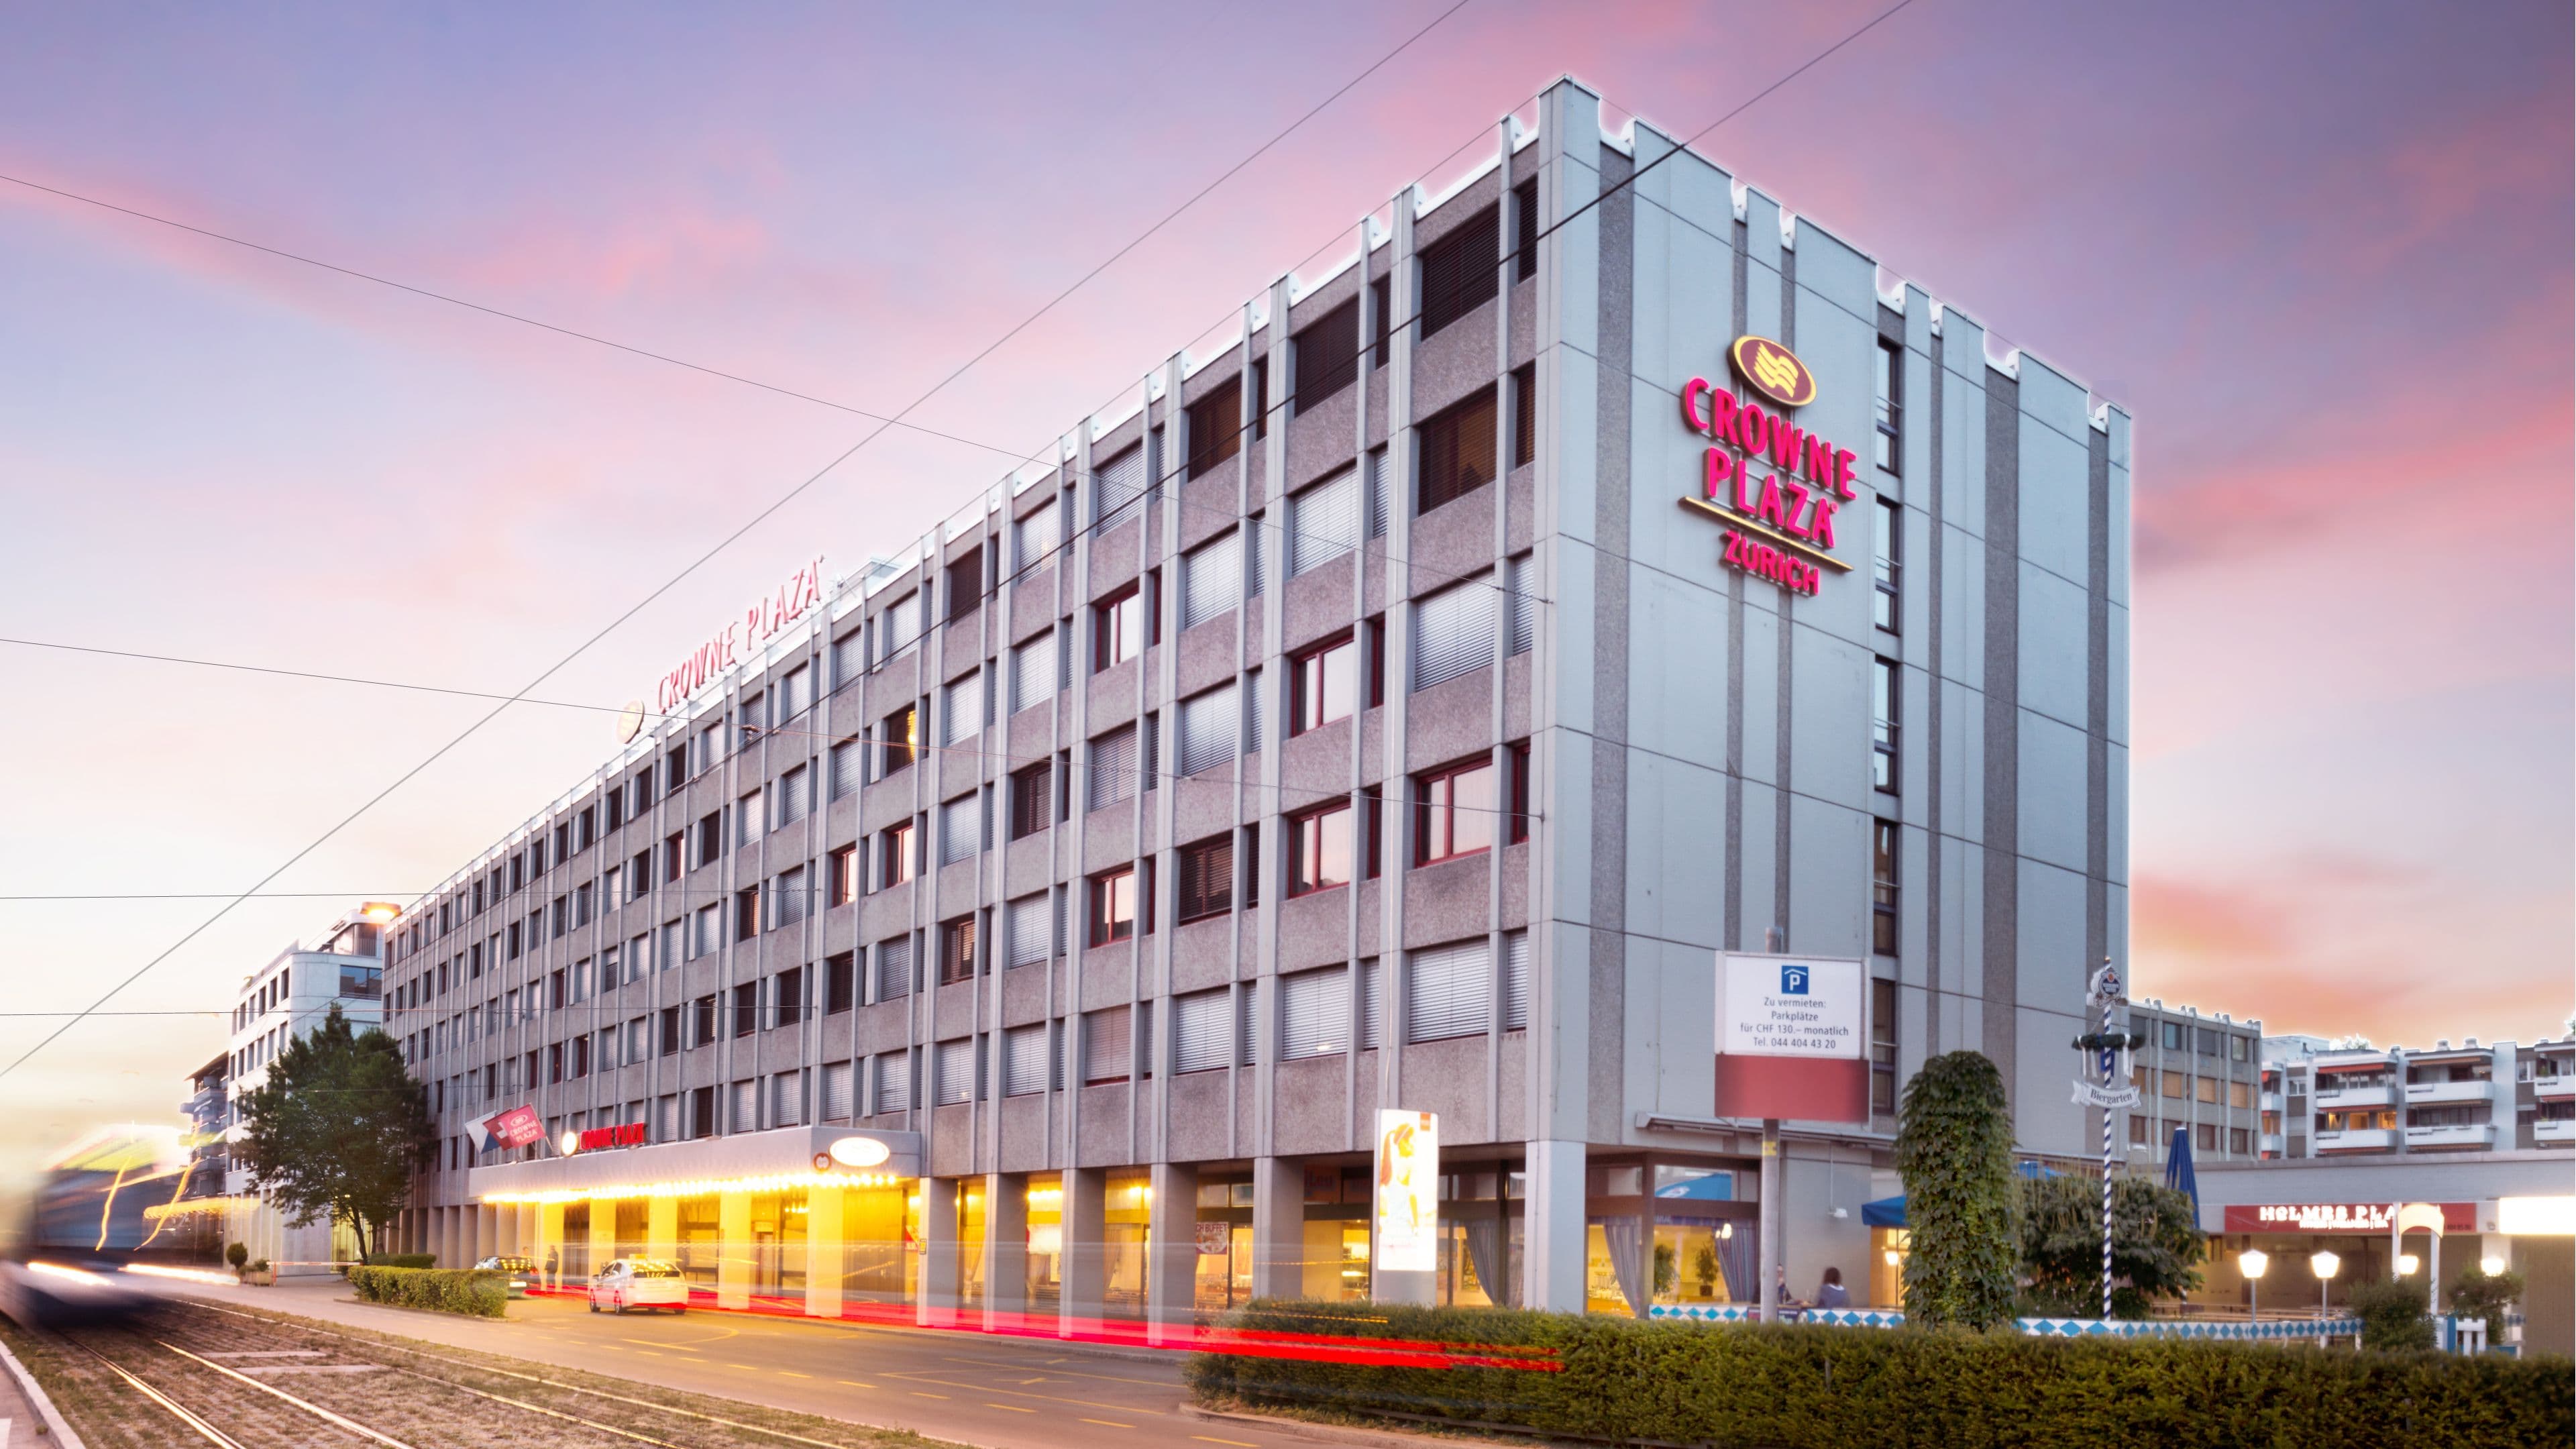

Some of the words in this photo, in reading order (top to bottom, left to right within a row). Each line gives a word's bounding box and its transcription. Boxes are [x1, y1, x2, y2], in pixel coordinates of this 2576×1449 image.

[1682, 376, 1857, 500] CROWNE
[1723, 530, 1819, 596] ZURICH
[658, 621, 738, 714] CROWNE
[1789, 974, 1801, 991] P
[1764, 997, 1775, 1006] Zu
[1778, 998, 1826, 1009] vermieten:
[1771, 1011, 1819, 1022] Parkplätze
[1740, 1022, 1753, 1032] für
[1756, 1024, 1774, 1034] CHF
[1804, 1026, 1849, 1036] monatlich
[1753, 1036, 1768, 1046] Tel.
[1771, 1038, 1788, 1047] 044
[1791, 1038, 1807, 1048] 404
[1811, 1039, 1822, 1049] 43
[1825, 1039, 1836, 1049] 20
[2090, 1088, 2132, 1106] Biergarten
[1205, 1223, 1228, 1232] BUFFET
